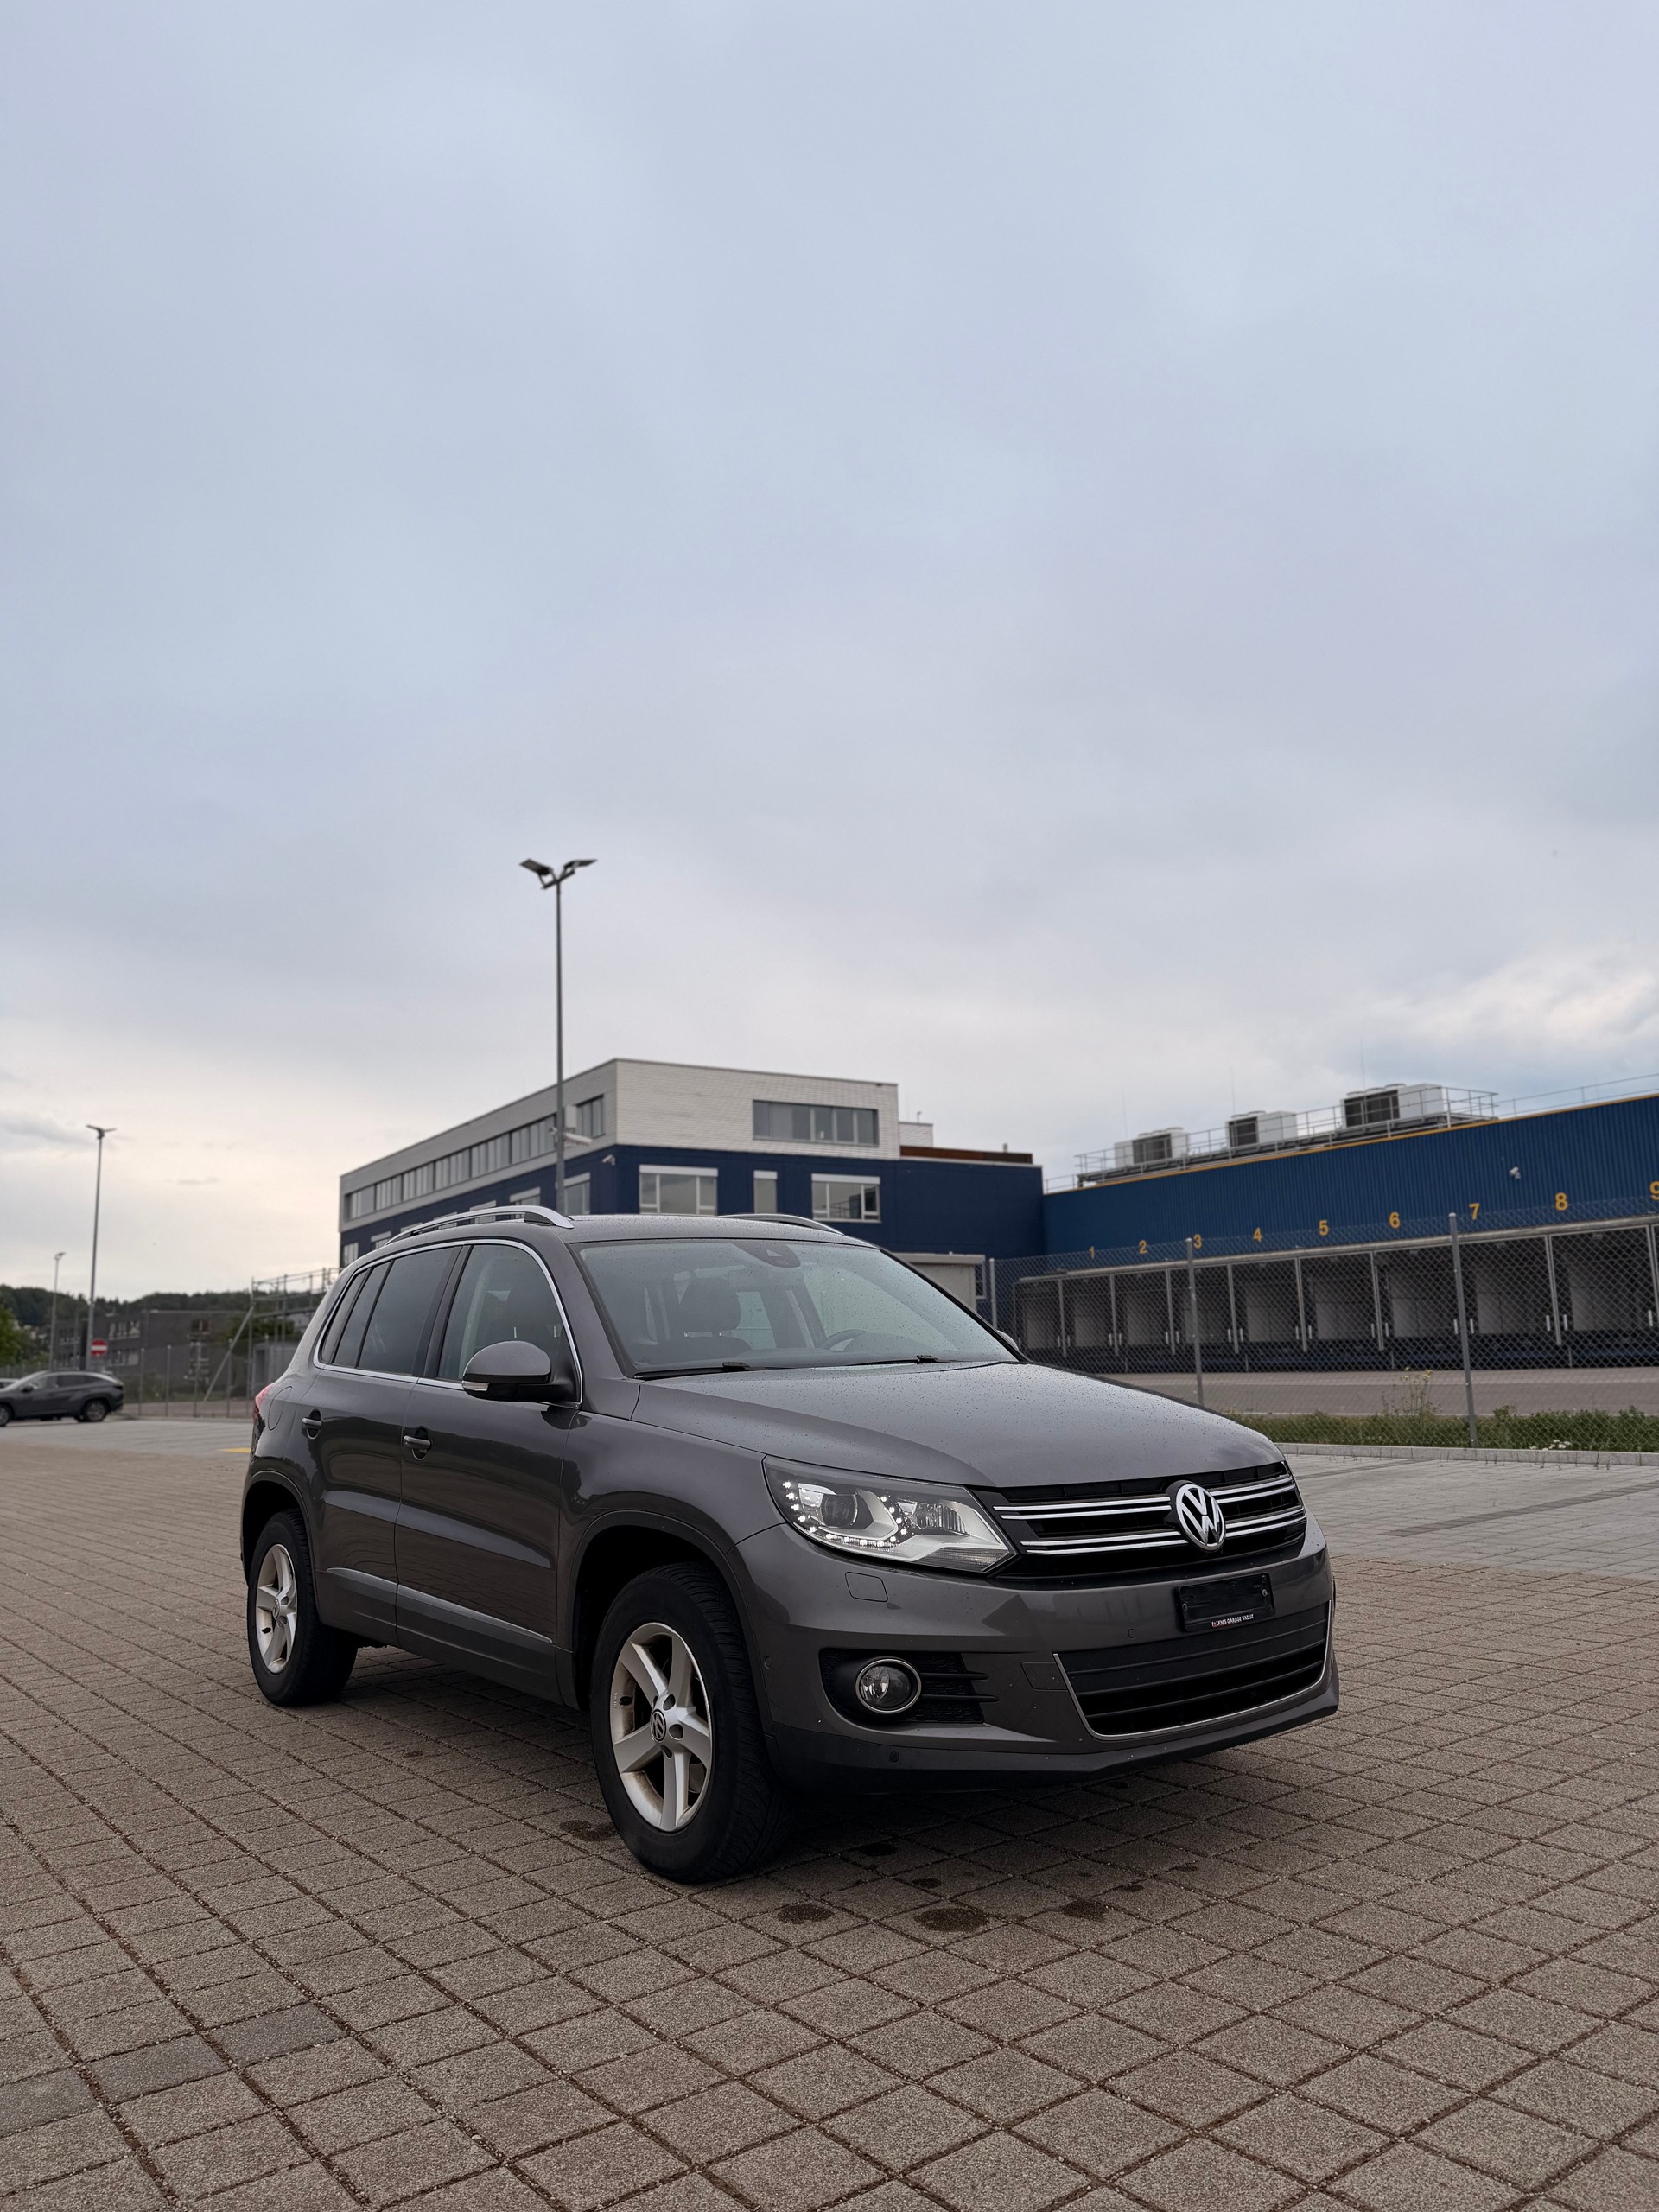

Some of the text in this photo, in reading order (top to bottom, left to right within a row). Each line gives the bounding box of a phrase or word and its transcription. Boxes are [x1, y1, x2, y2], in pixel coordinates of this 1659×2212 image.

[1649, 1180, 1659, 1201] 9
[1555, 1192, 1568, 1211] 8
[1469, 1203, 1480, 1220] 7
[1319, 1219, 1329, 1236] 5
[1389, 1212, 1400, 1229] 6
[1193, 1234, 1202, 1249] 3
[1253, 1228, 1262, 1243] 4
[1089, 1246, 1095, 1259] 1
[1139, 1240, 1147, 1255] 2
[1176, 1484, 1225, 1551] VW
